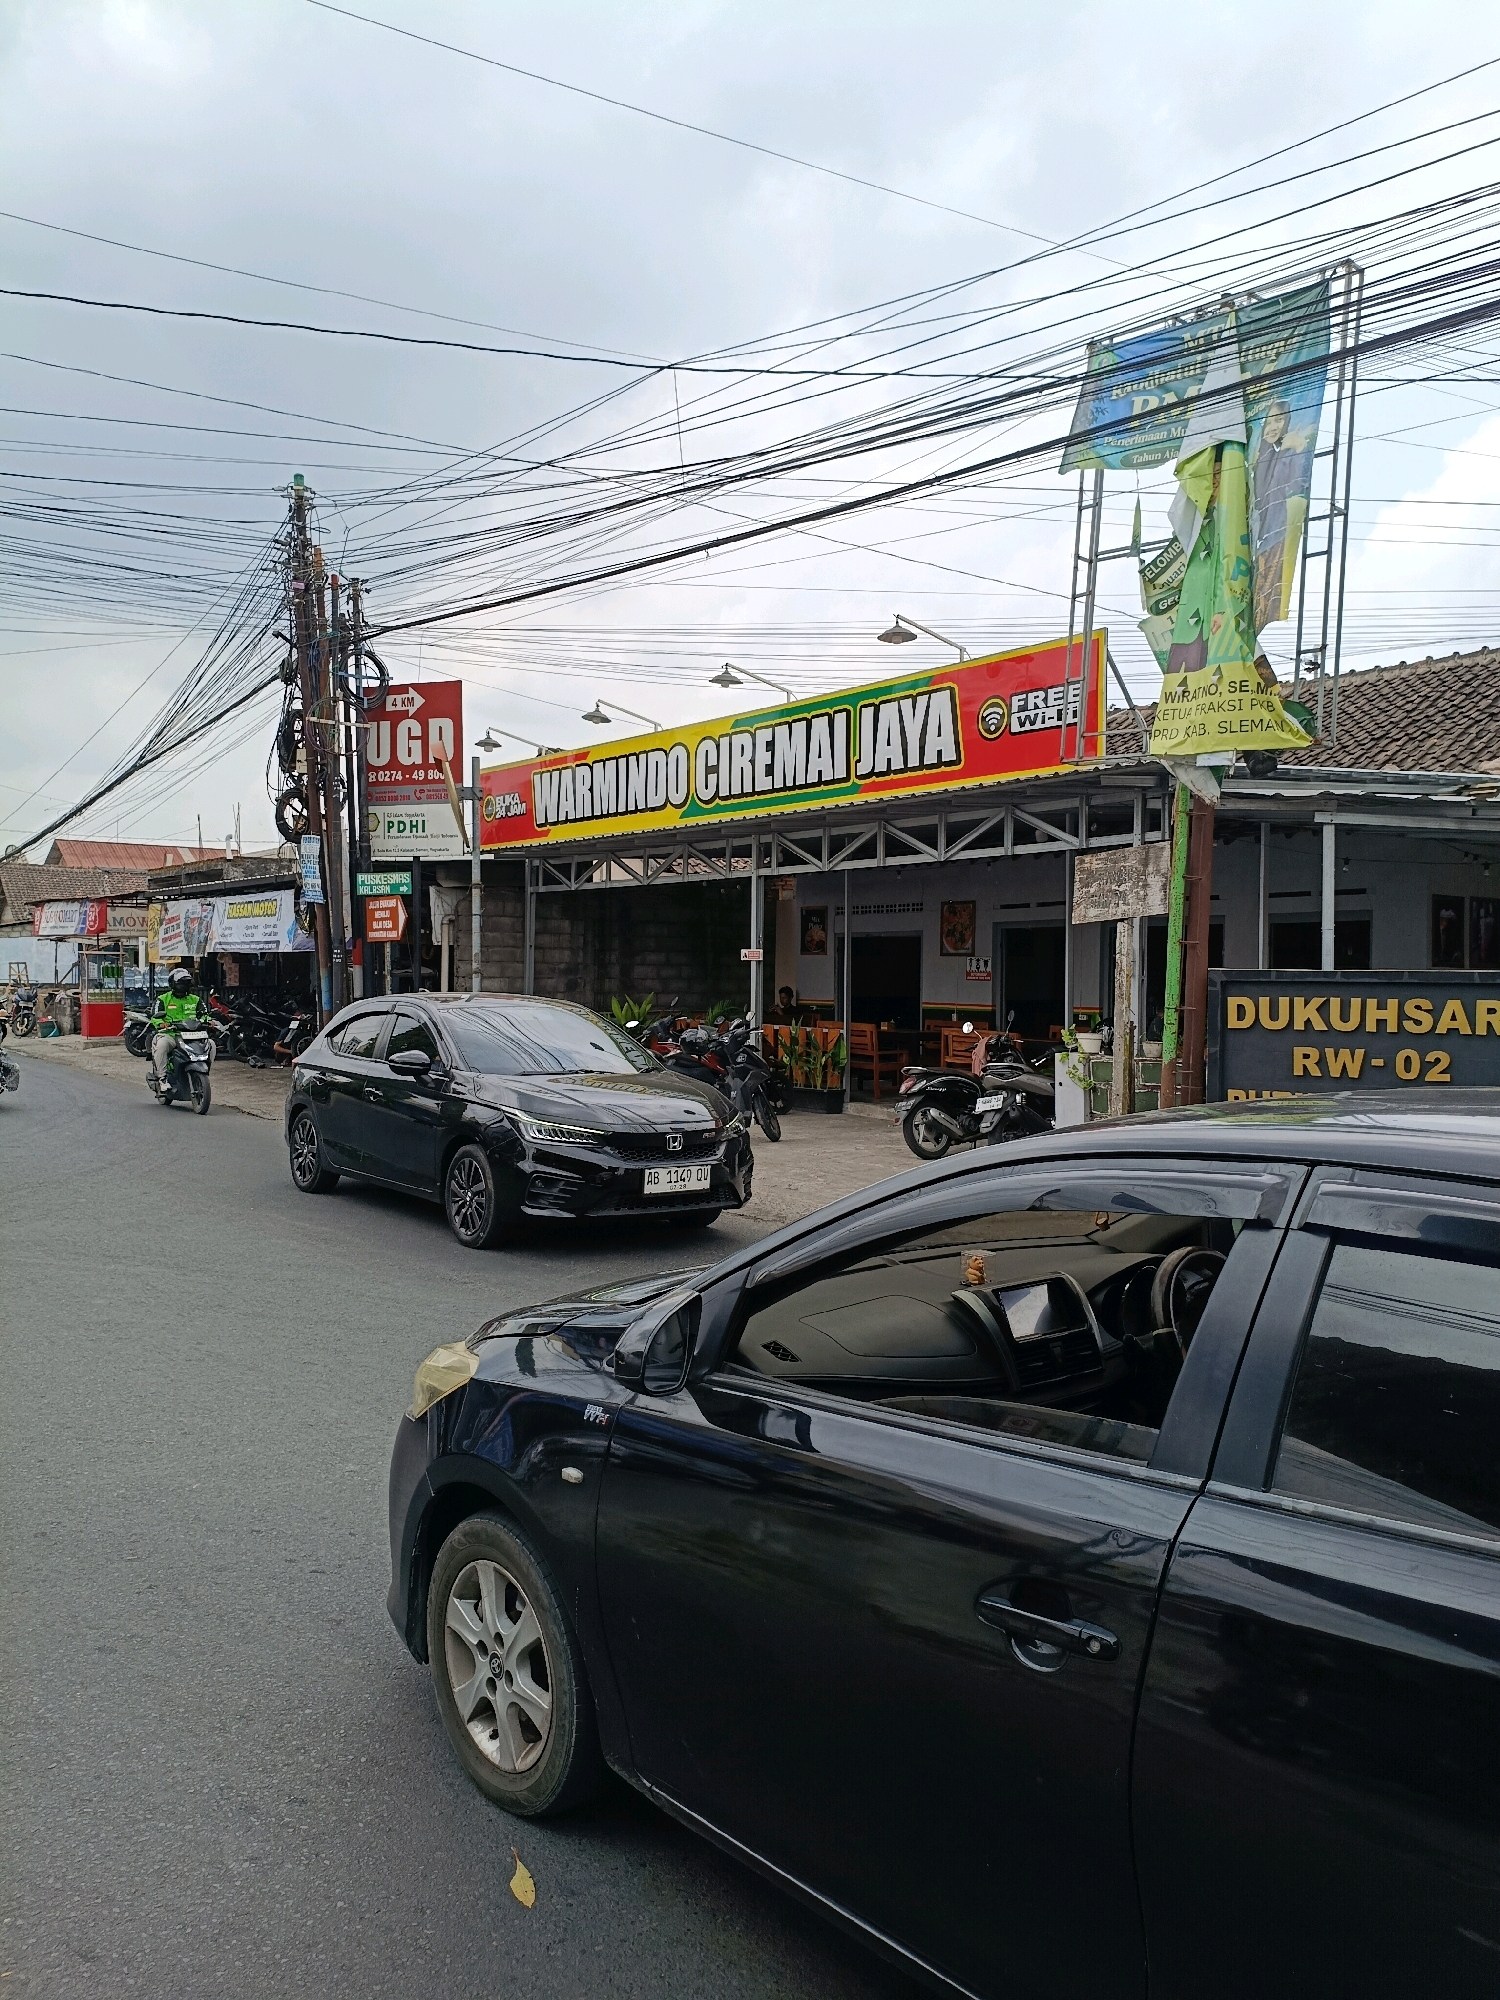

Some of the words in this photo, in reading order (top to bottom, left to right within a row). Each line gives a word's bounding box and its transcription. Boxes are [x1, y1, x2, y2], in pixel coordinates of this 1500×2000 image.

[1103, 431, 1167, 446] Penerimaan
[1132, 452, 1161, 464] Tahun
[391, 697, 398, 708] 4
[401, 696, 415, 708] KM
[1011, 683, 1081, 714] FREE
[1194, 698, 1244, 717] FRAKSI
[1250, 698, 1276, 713] PKB
[1149, 727, 1179, 742] PRD
[1183, 723, 1210, 739] KAB.
[1217, 718, 1285, 735] SLEMAN
[533, 746, 689, 826] WARMINDO
[696, 711, 848, 802] CIREMAI
[856, 689, 957, 776] JAYA
[377, 770, 403, 781] 0274
[412, 769, 425, 781] 49
[496, 793, 520, 808] BUKA
[495, 806, 506, 819] 24
[507, 802, 526, 817] JAM
[387, 820, 426, 834] PDHI
[358, 873, 410, 885] PUSKESMAS
[359, 885, 391, 895] KALASAN
[646, 1171, 660, 1186] AB
